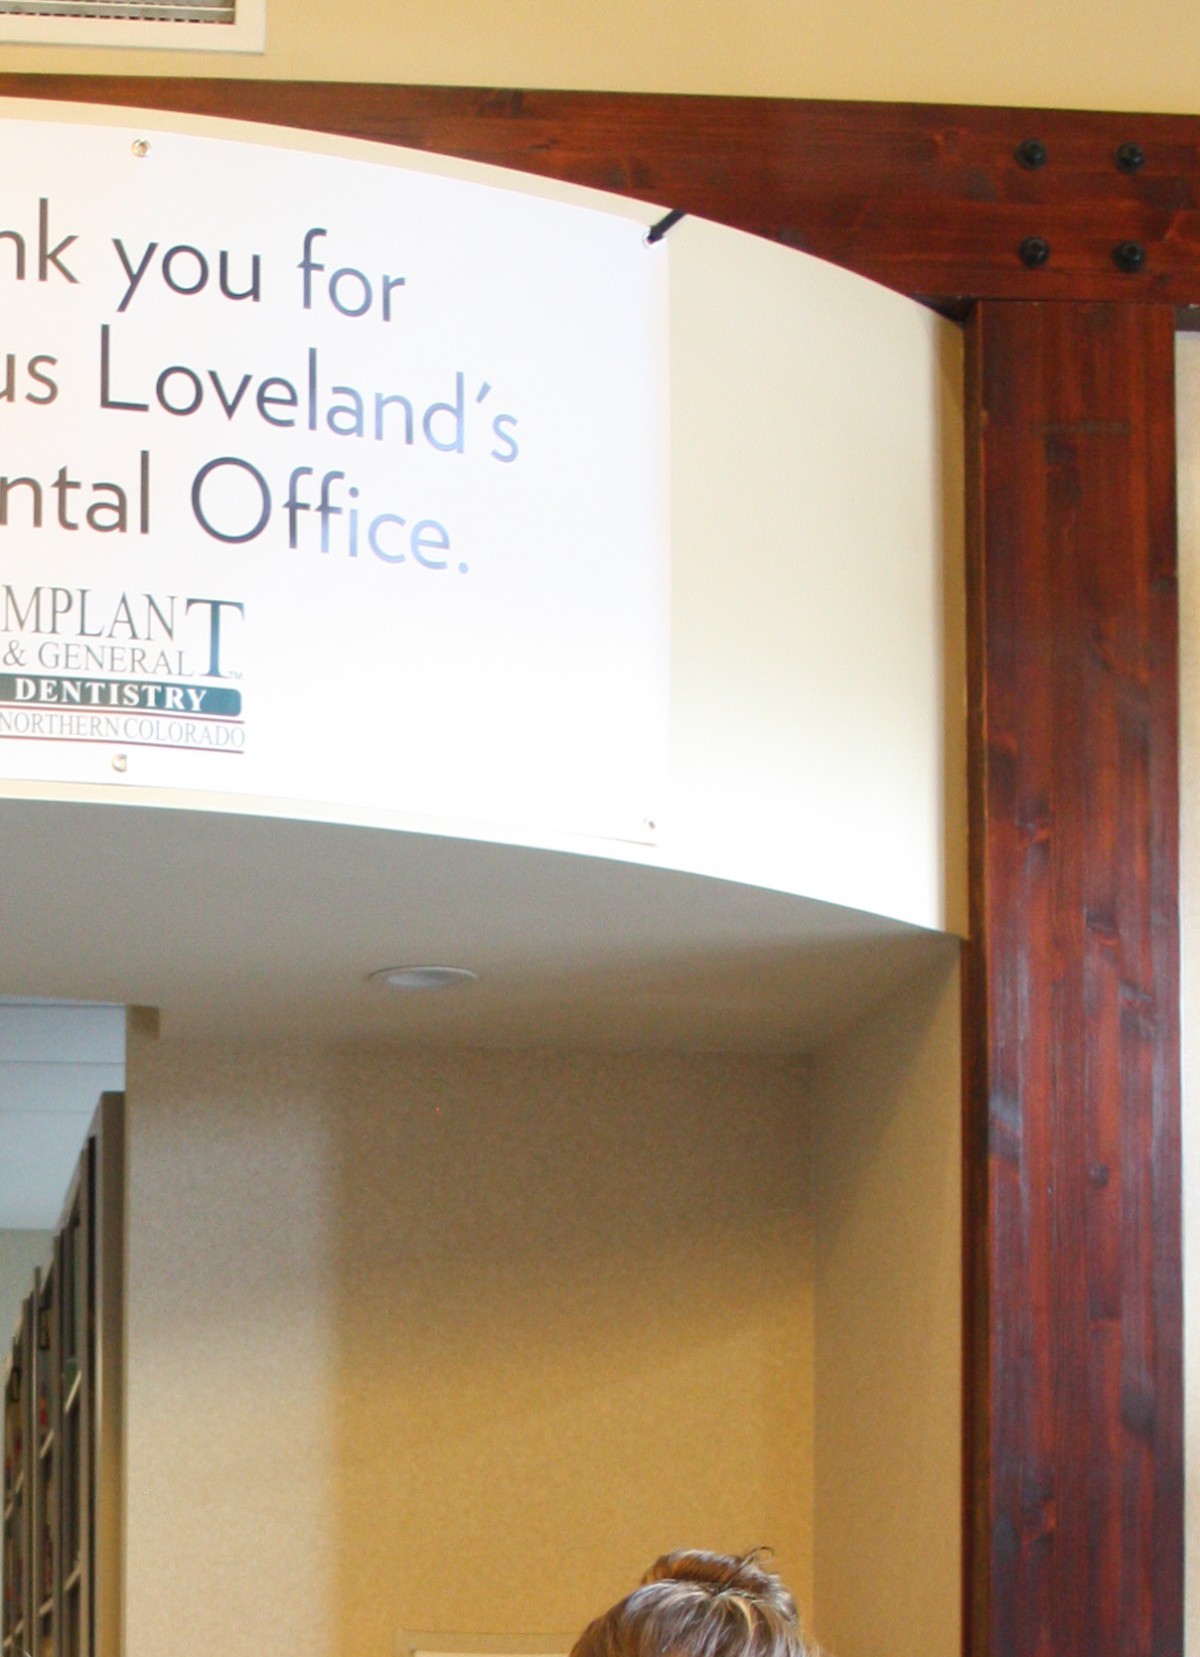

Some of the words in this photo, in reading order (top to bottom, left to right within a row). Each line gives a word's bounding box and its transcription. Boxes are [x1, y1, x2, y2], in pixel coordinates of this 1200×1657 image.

[111, 236, 264, 313] you
[296, 227, 407, 322] for
[191, 456, 470, 574] Office.
[3, 639, 28, 668] &
[38, 640, 194, 678] GENERAL
[15, 678, 208, 712] DENTISTRY
[123, 717, 246, 748] COLORADO
